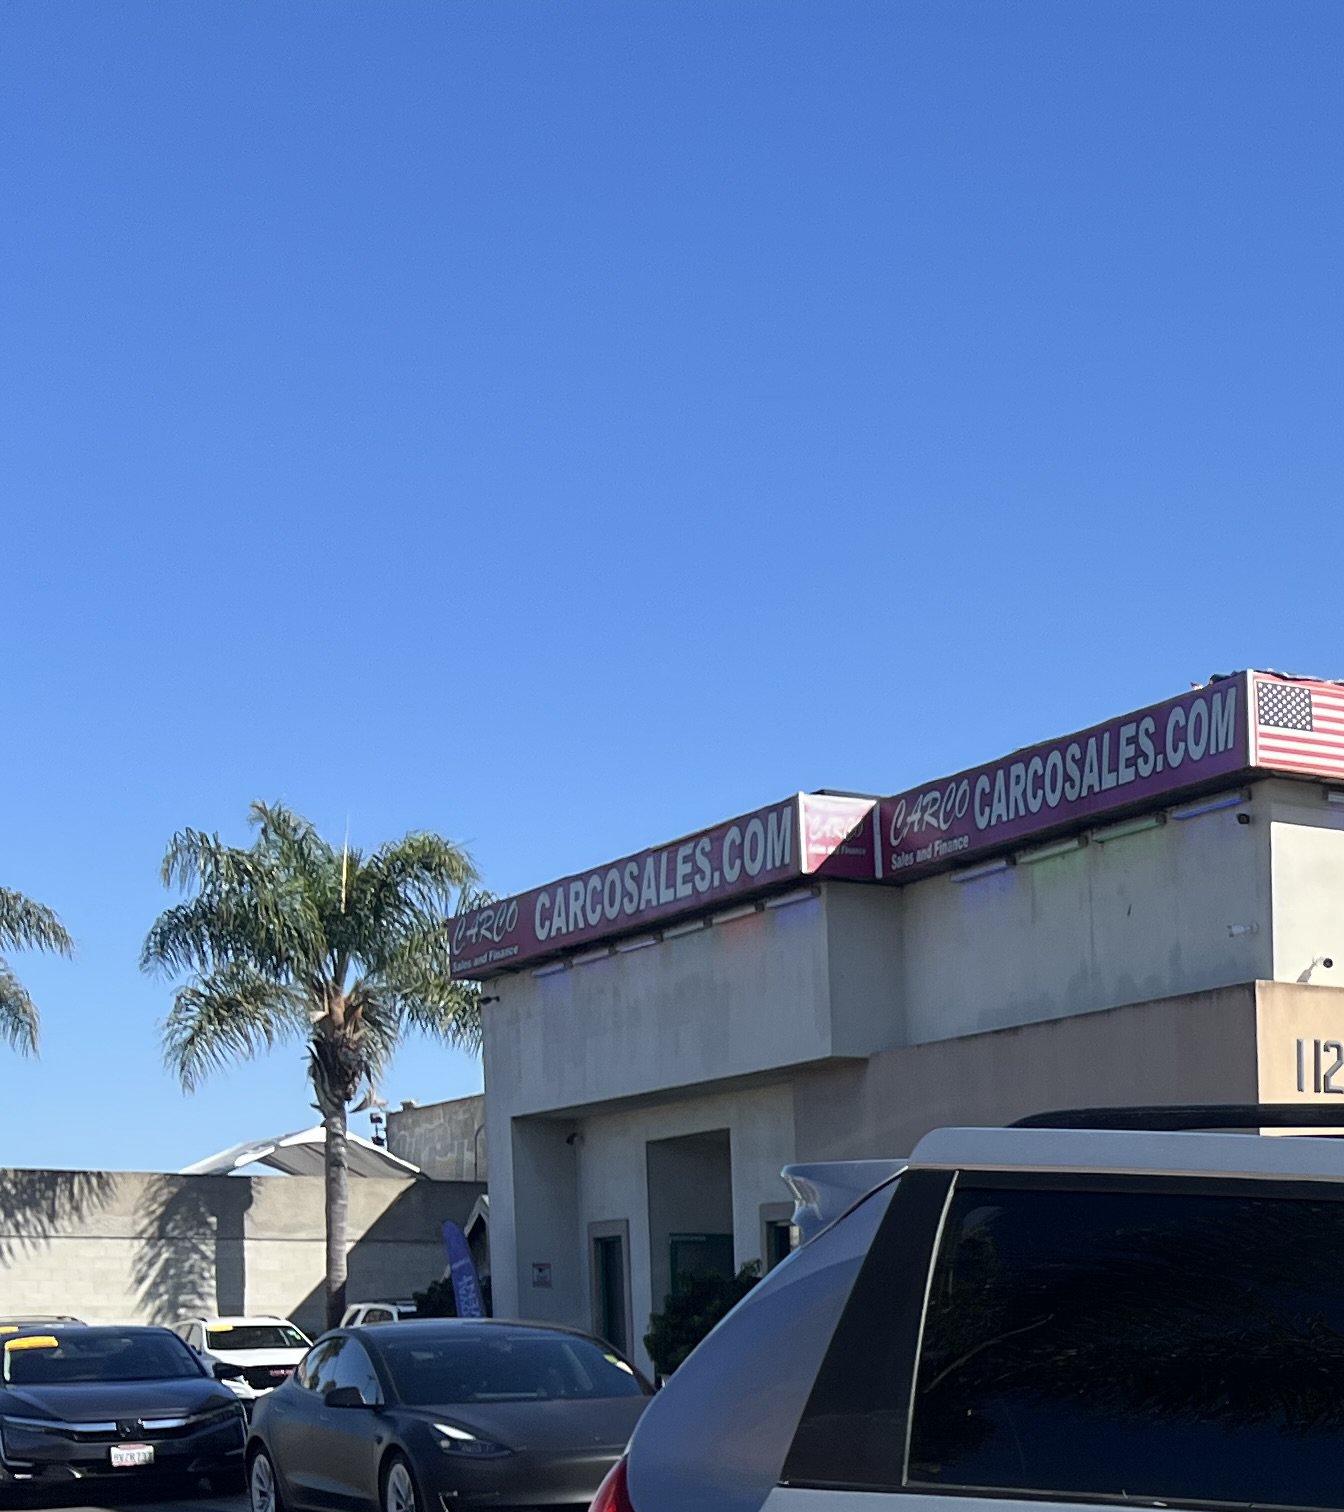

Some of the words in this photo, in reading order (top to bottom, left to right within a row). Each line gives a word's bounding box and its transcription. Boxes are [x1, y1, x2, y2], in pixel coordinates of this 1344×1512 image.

[973, 686, 1238, 830] CARCOSALES.COM
[890, 779, 970, 847] CARCO
[534, 806, 792, 941] CARCOSALES.COM
[891, 851, 914, 871] Sales
[916, 842, 933, 863] and
[933, 835, 969, 858] Finance
[453, 900, 519, 955] CARCO
